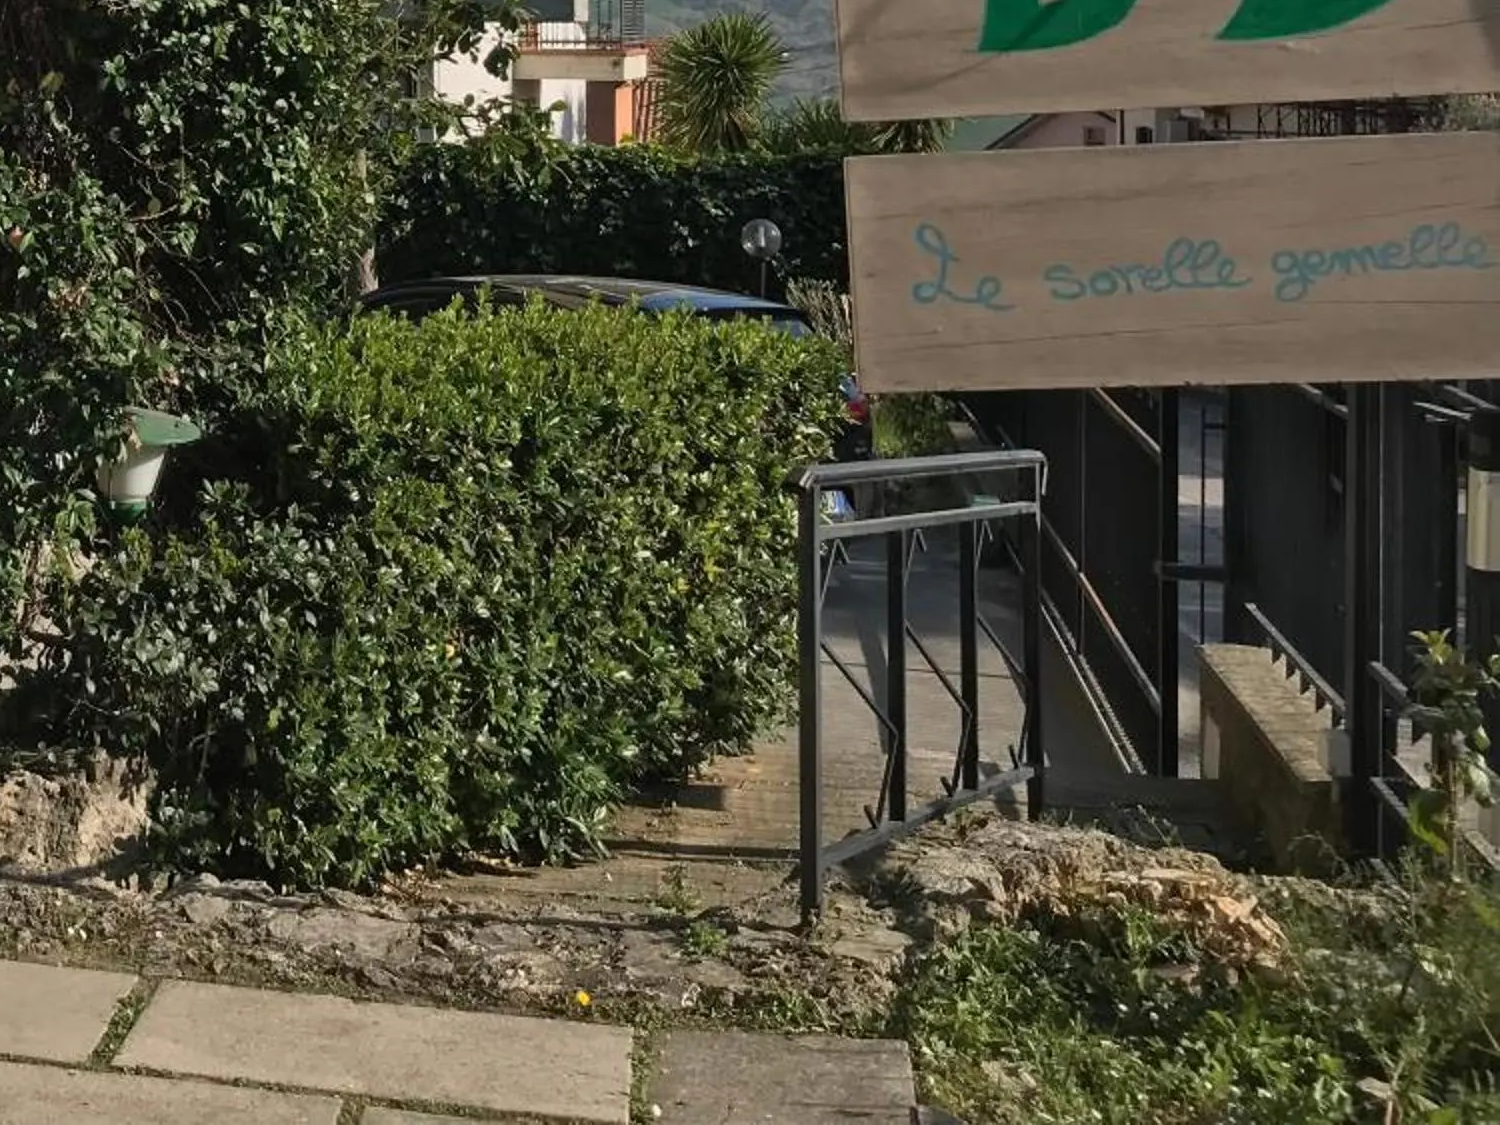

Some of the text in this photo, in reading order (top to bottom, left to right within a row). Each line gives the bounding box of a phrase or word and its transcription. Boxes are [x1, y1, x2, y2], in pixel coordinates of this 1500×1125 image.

[911, 220, 1500, 312] Le sorelle gemelle
